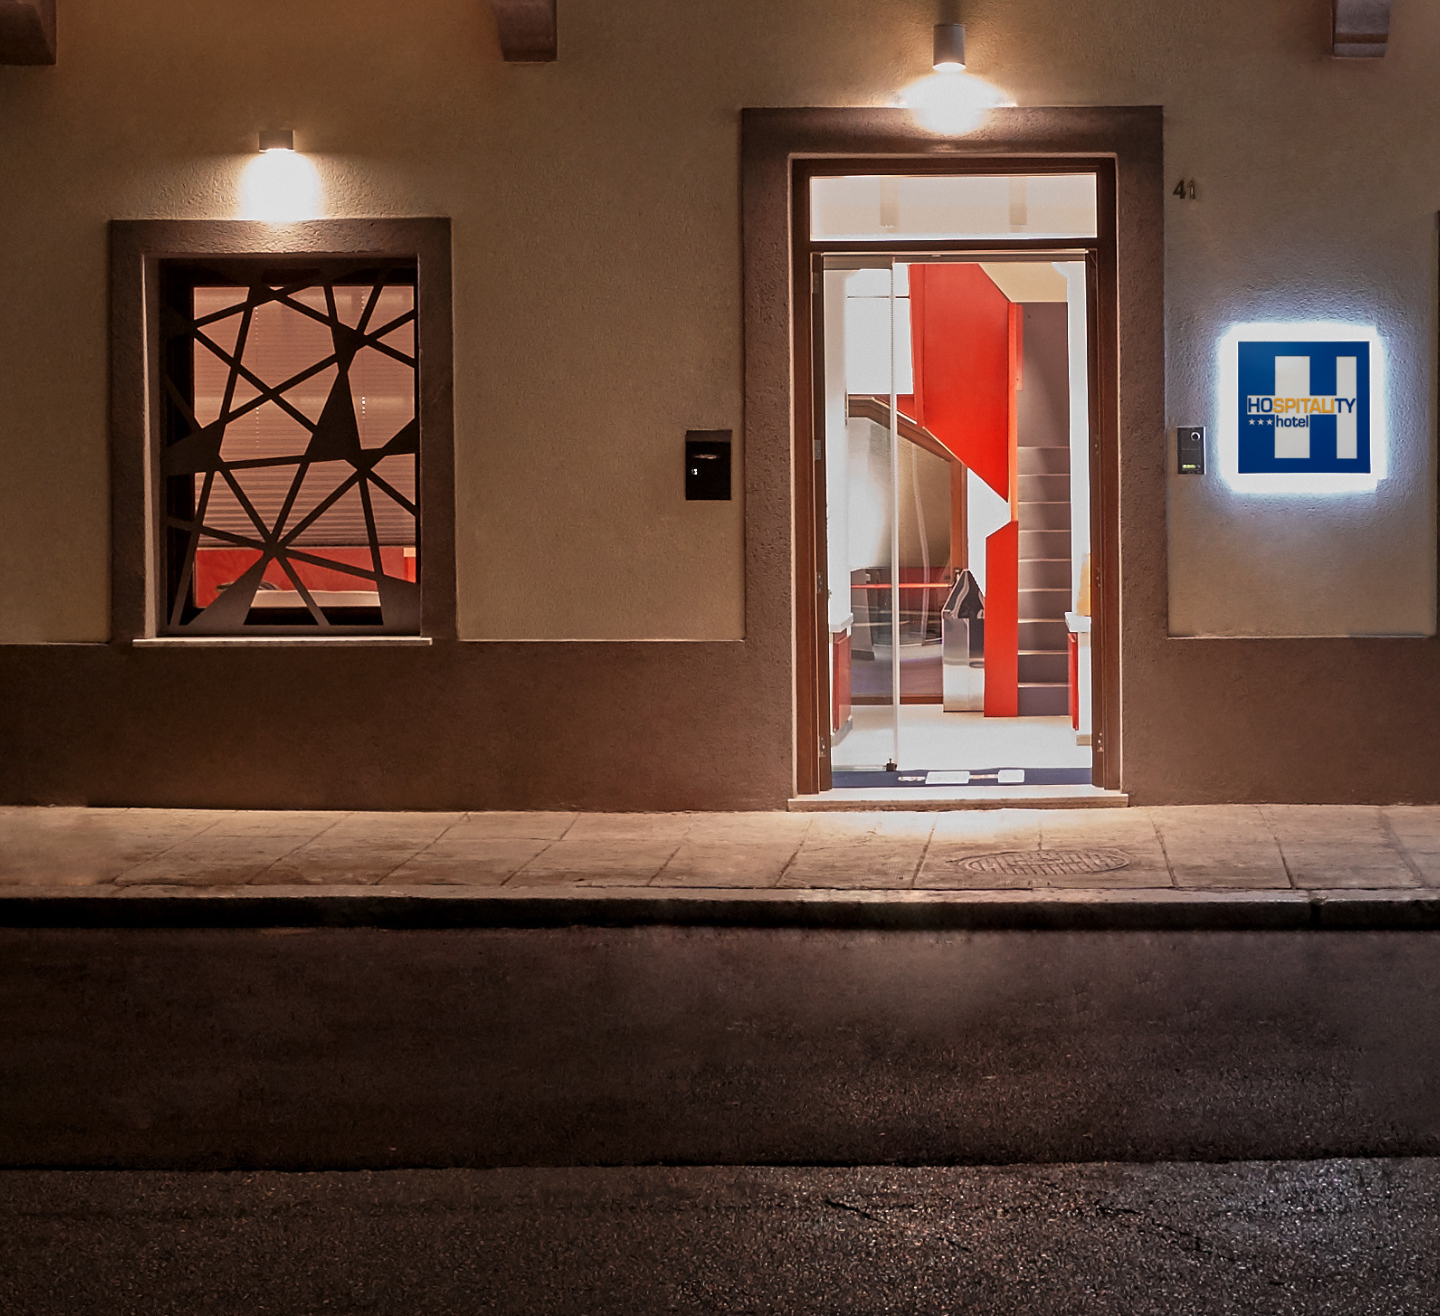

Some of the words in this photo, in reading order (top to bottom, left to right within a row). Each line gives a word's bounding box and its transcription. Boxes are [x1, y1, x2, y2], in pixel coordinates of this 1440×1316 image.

[1172, 179, 1196, 200] 41
[1247, 397, 1356, 414] HOSPITALITY
[1275, 415, 1309, 428] hotel
